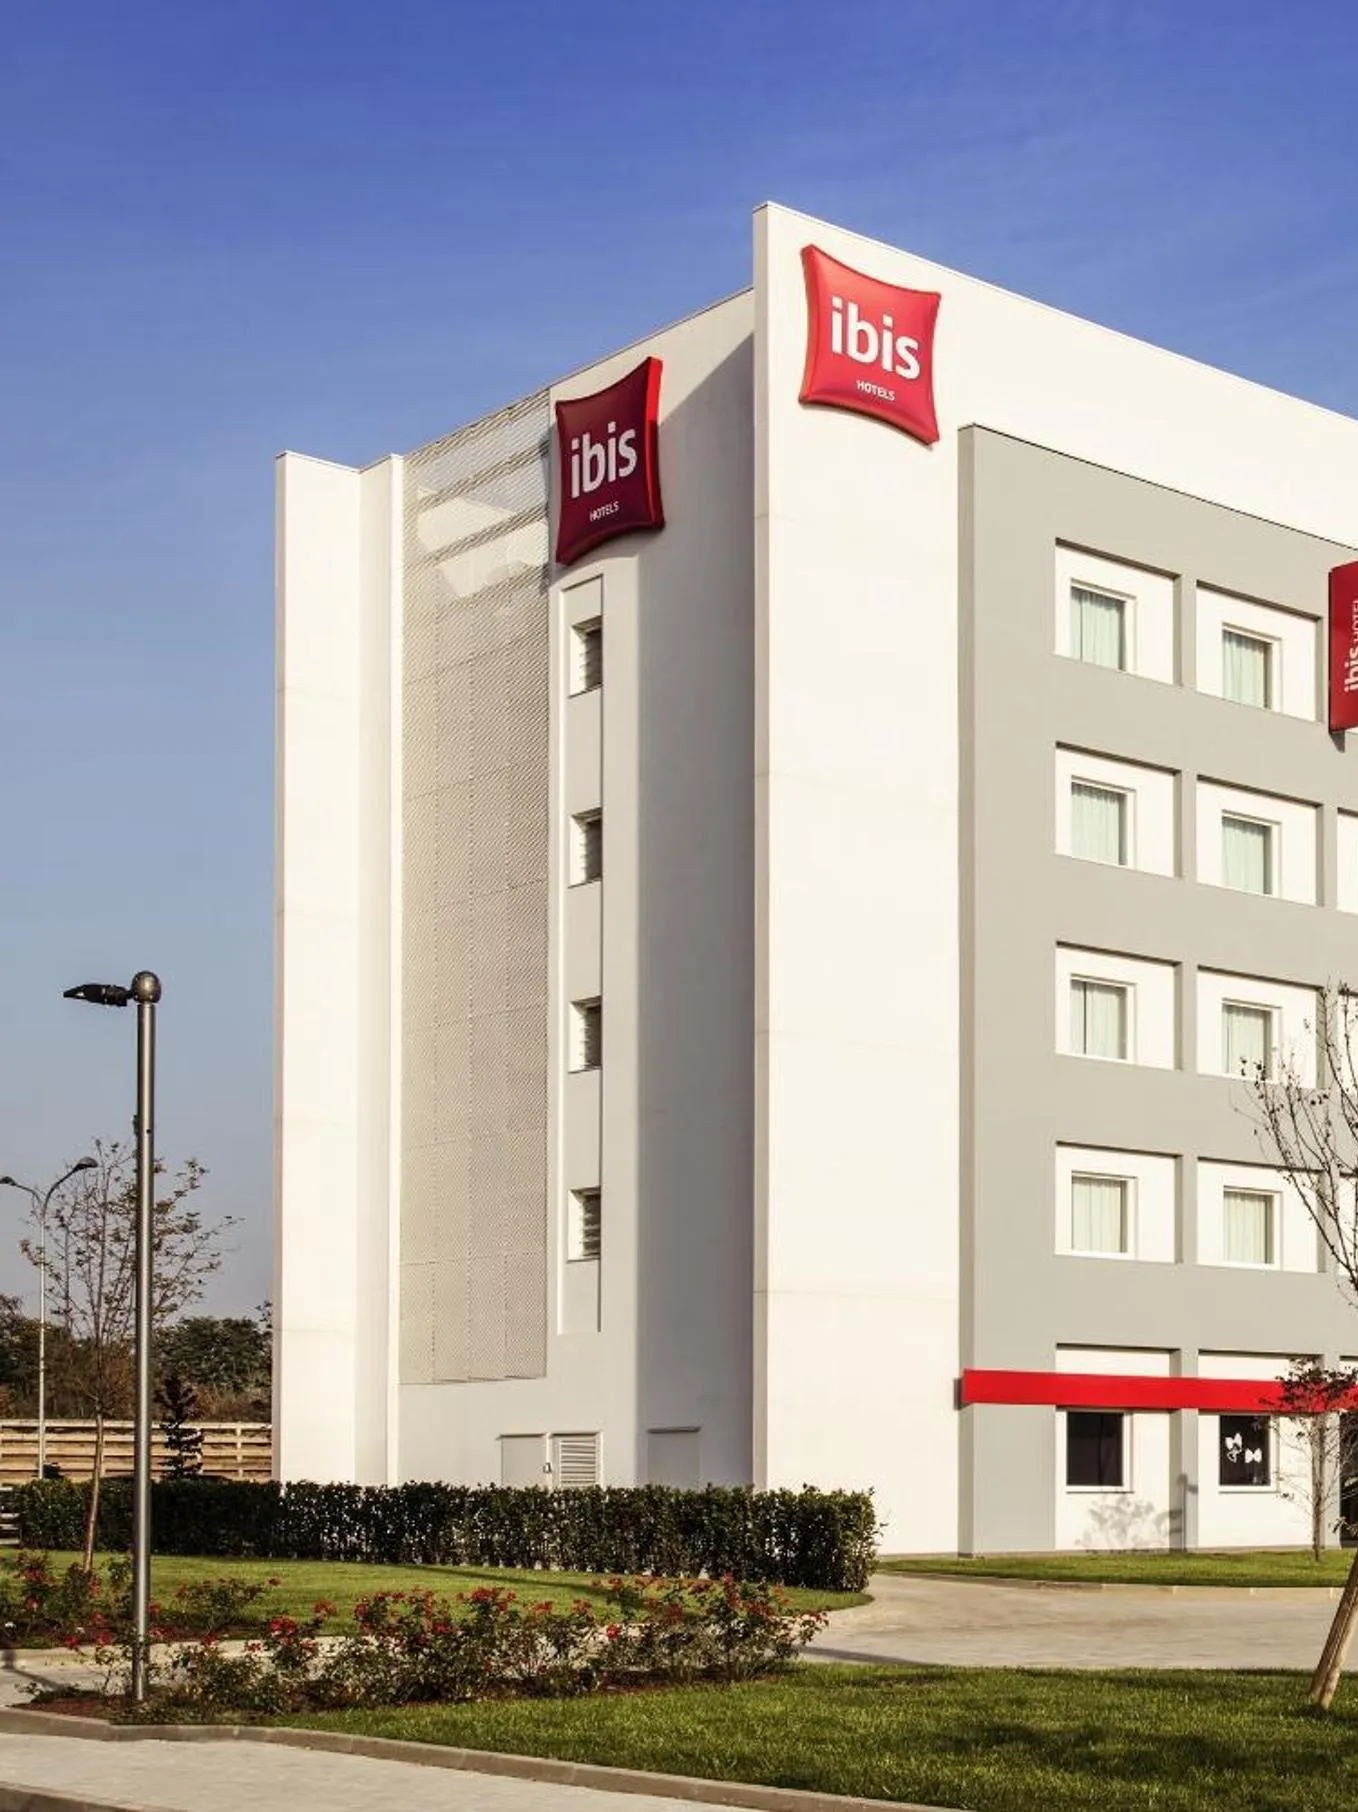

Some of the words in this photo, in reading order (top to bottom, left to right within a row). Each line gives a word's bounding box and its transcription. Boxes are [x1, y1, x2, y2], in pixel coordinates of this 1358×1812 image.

[831, 295, 921, 380] ibis
[857, 379, 896, 402] HOTELS
[571, 420, 638, 499] ibis
[589, 500, 620, 522] HOTELS
